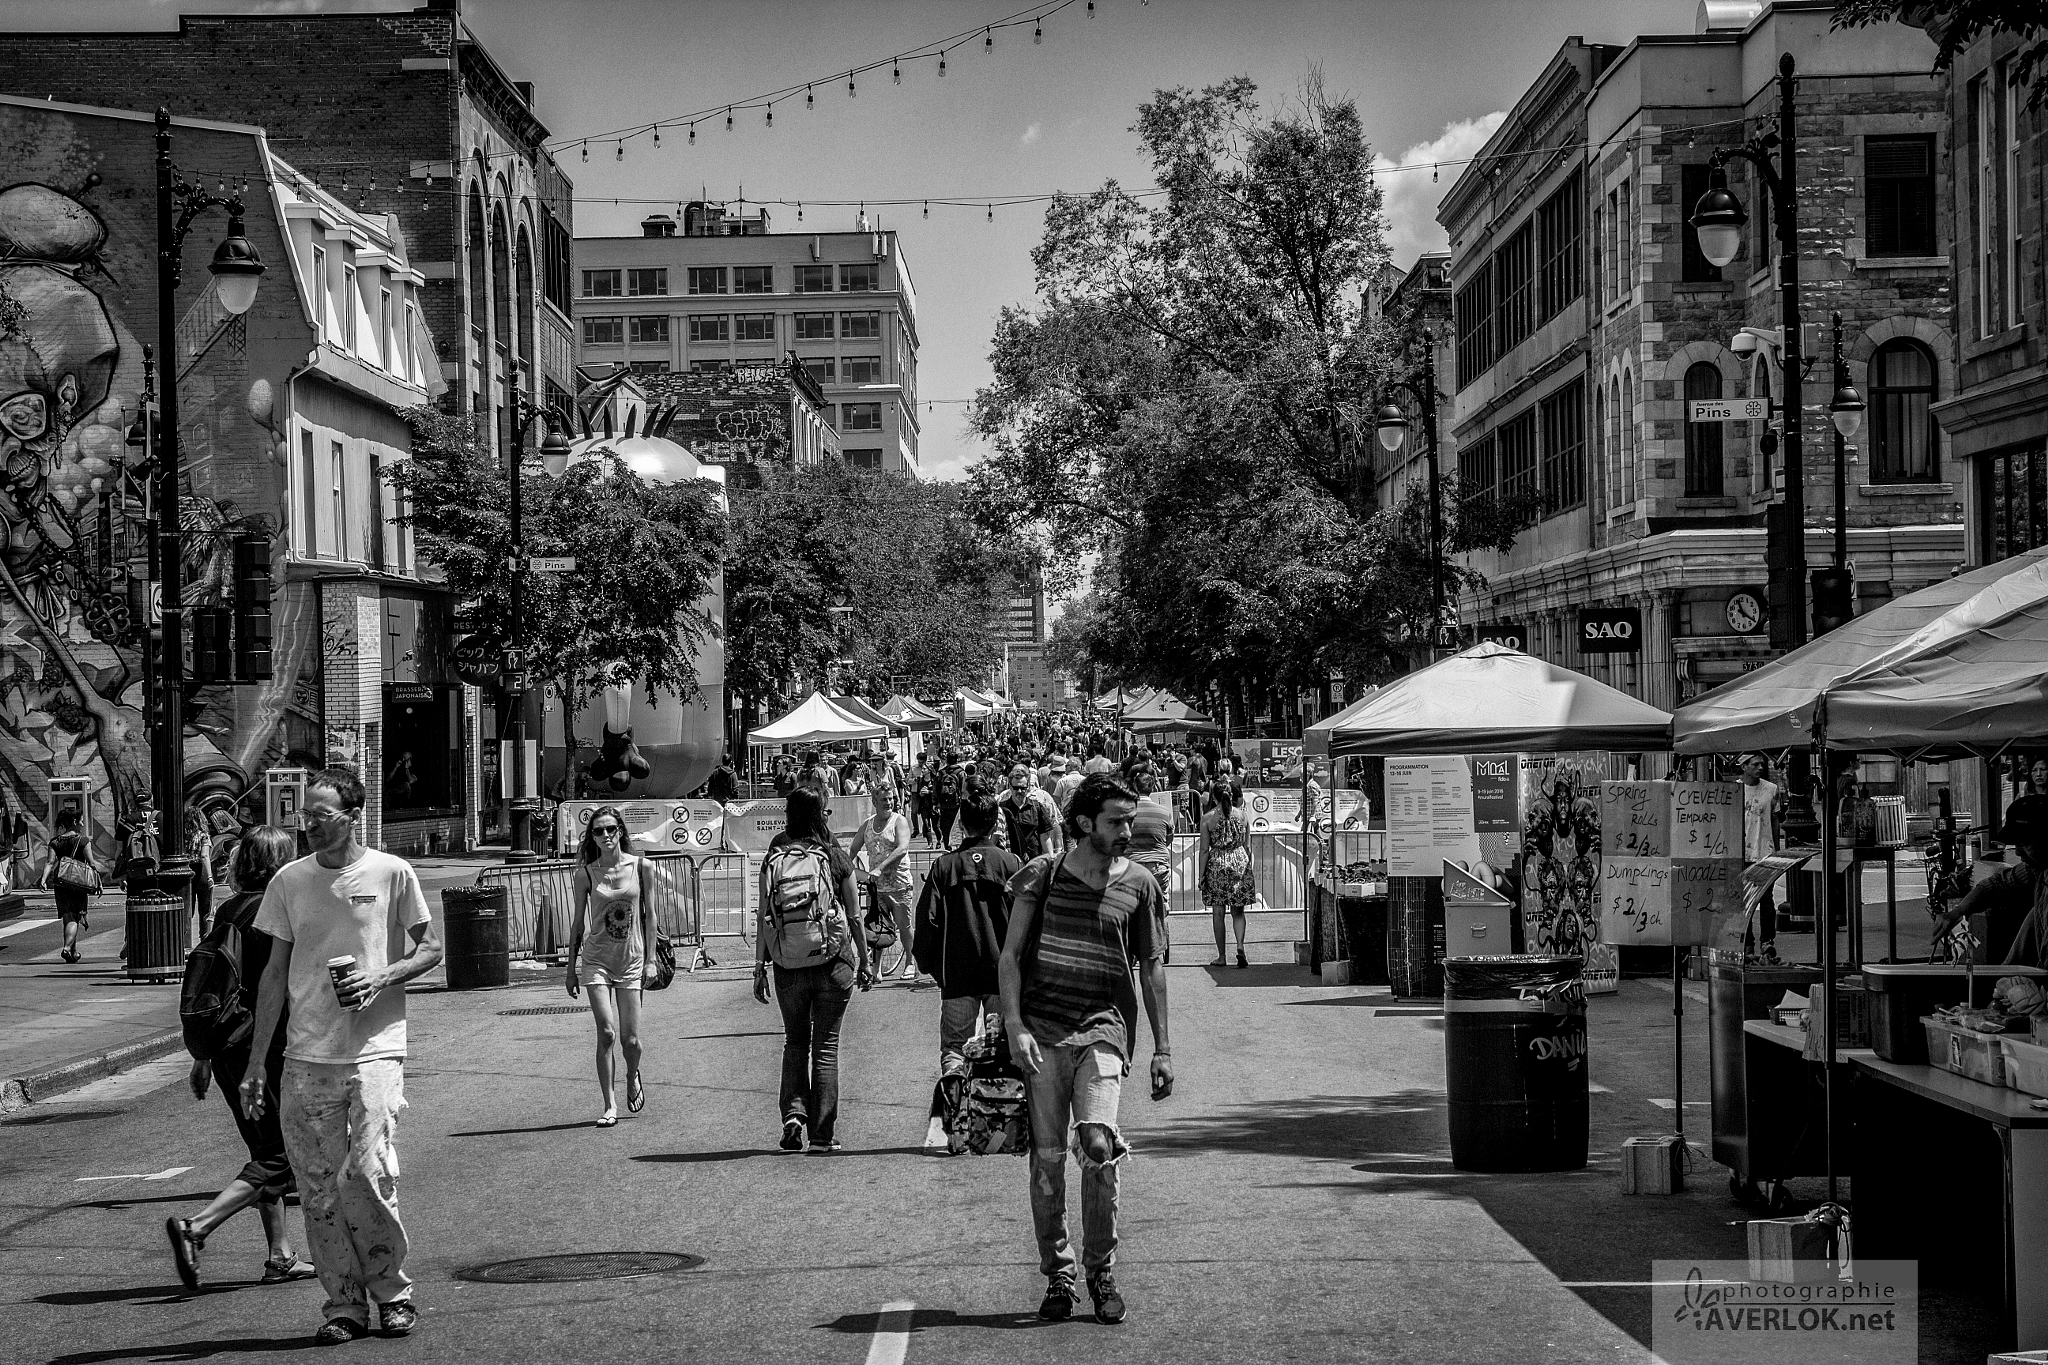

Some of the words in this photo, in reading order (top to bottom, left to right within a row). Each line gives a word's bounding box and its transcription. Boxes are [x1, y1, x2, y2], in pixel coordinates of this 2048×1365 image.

[1696, 407, 1731, 418] Pins
[1585, 621, 1633, 639] SAQ
[458, 661, 499, 674] ジャパン
[278, 773, 292, 781] Bell
[59, 782, 75, 791] Bell
[1675, 807, 1717, 826] TEMPURA
[1615, 831, 1624, 850] $
[1690, 829, 1698, 845] $
[1612, 895, 1622, 915] $
[1682, 888, 1692, 914] $
[1698, 887, 1722, 914] 2
